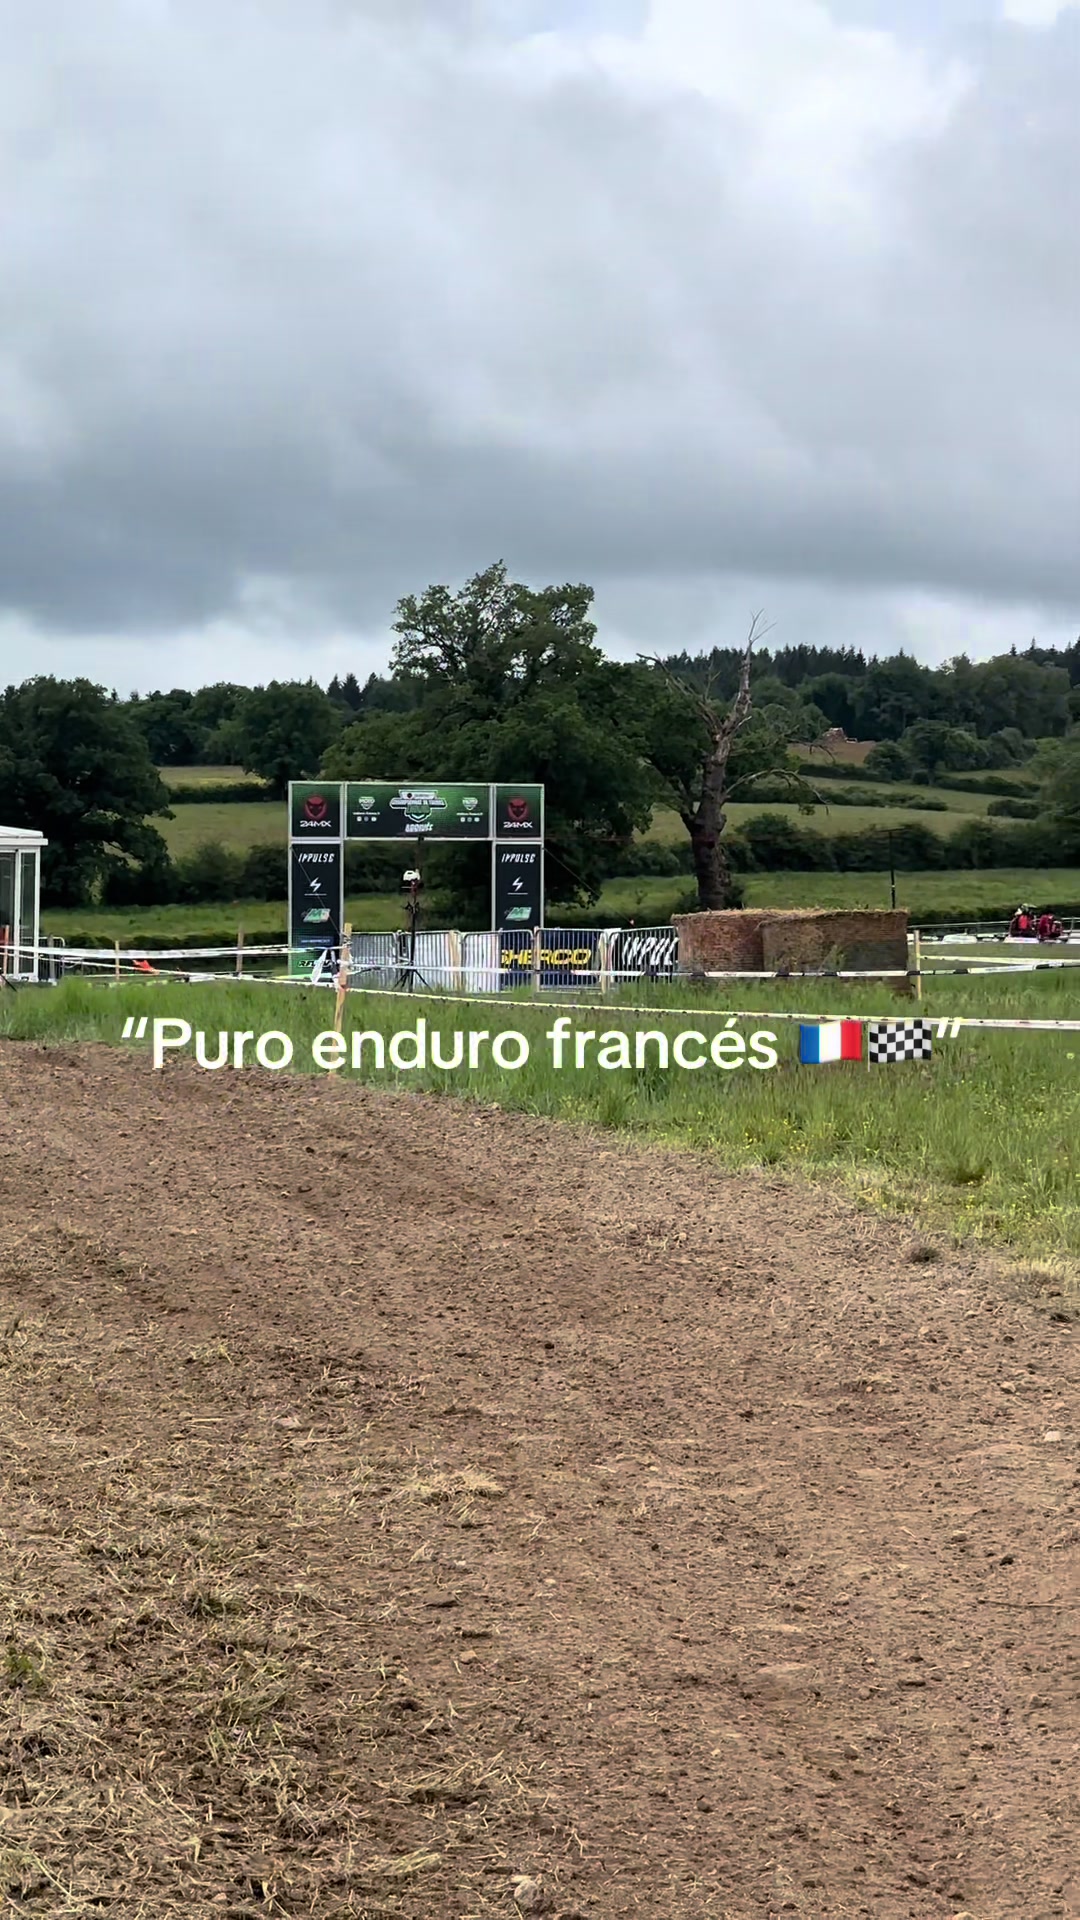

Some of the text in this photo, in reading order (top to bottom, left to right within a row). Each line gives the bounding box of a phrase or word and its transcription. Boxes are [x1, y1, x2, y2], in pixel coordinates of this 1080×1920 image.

[299, 820, 332, 828] 24MX
[503, 821, 534, 829] 24MX
[298, 853, 335, 863] IMPULSE
[501, 853, 537, 863] IMPULSE
